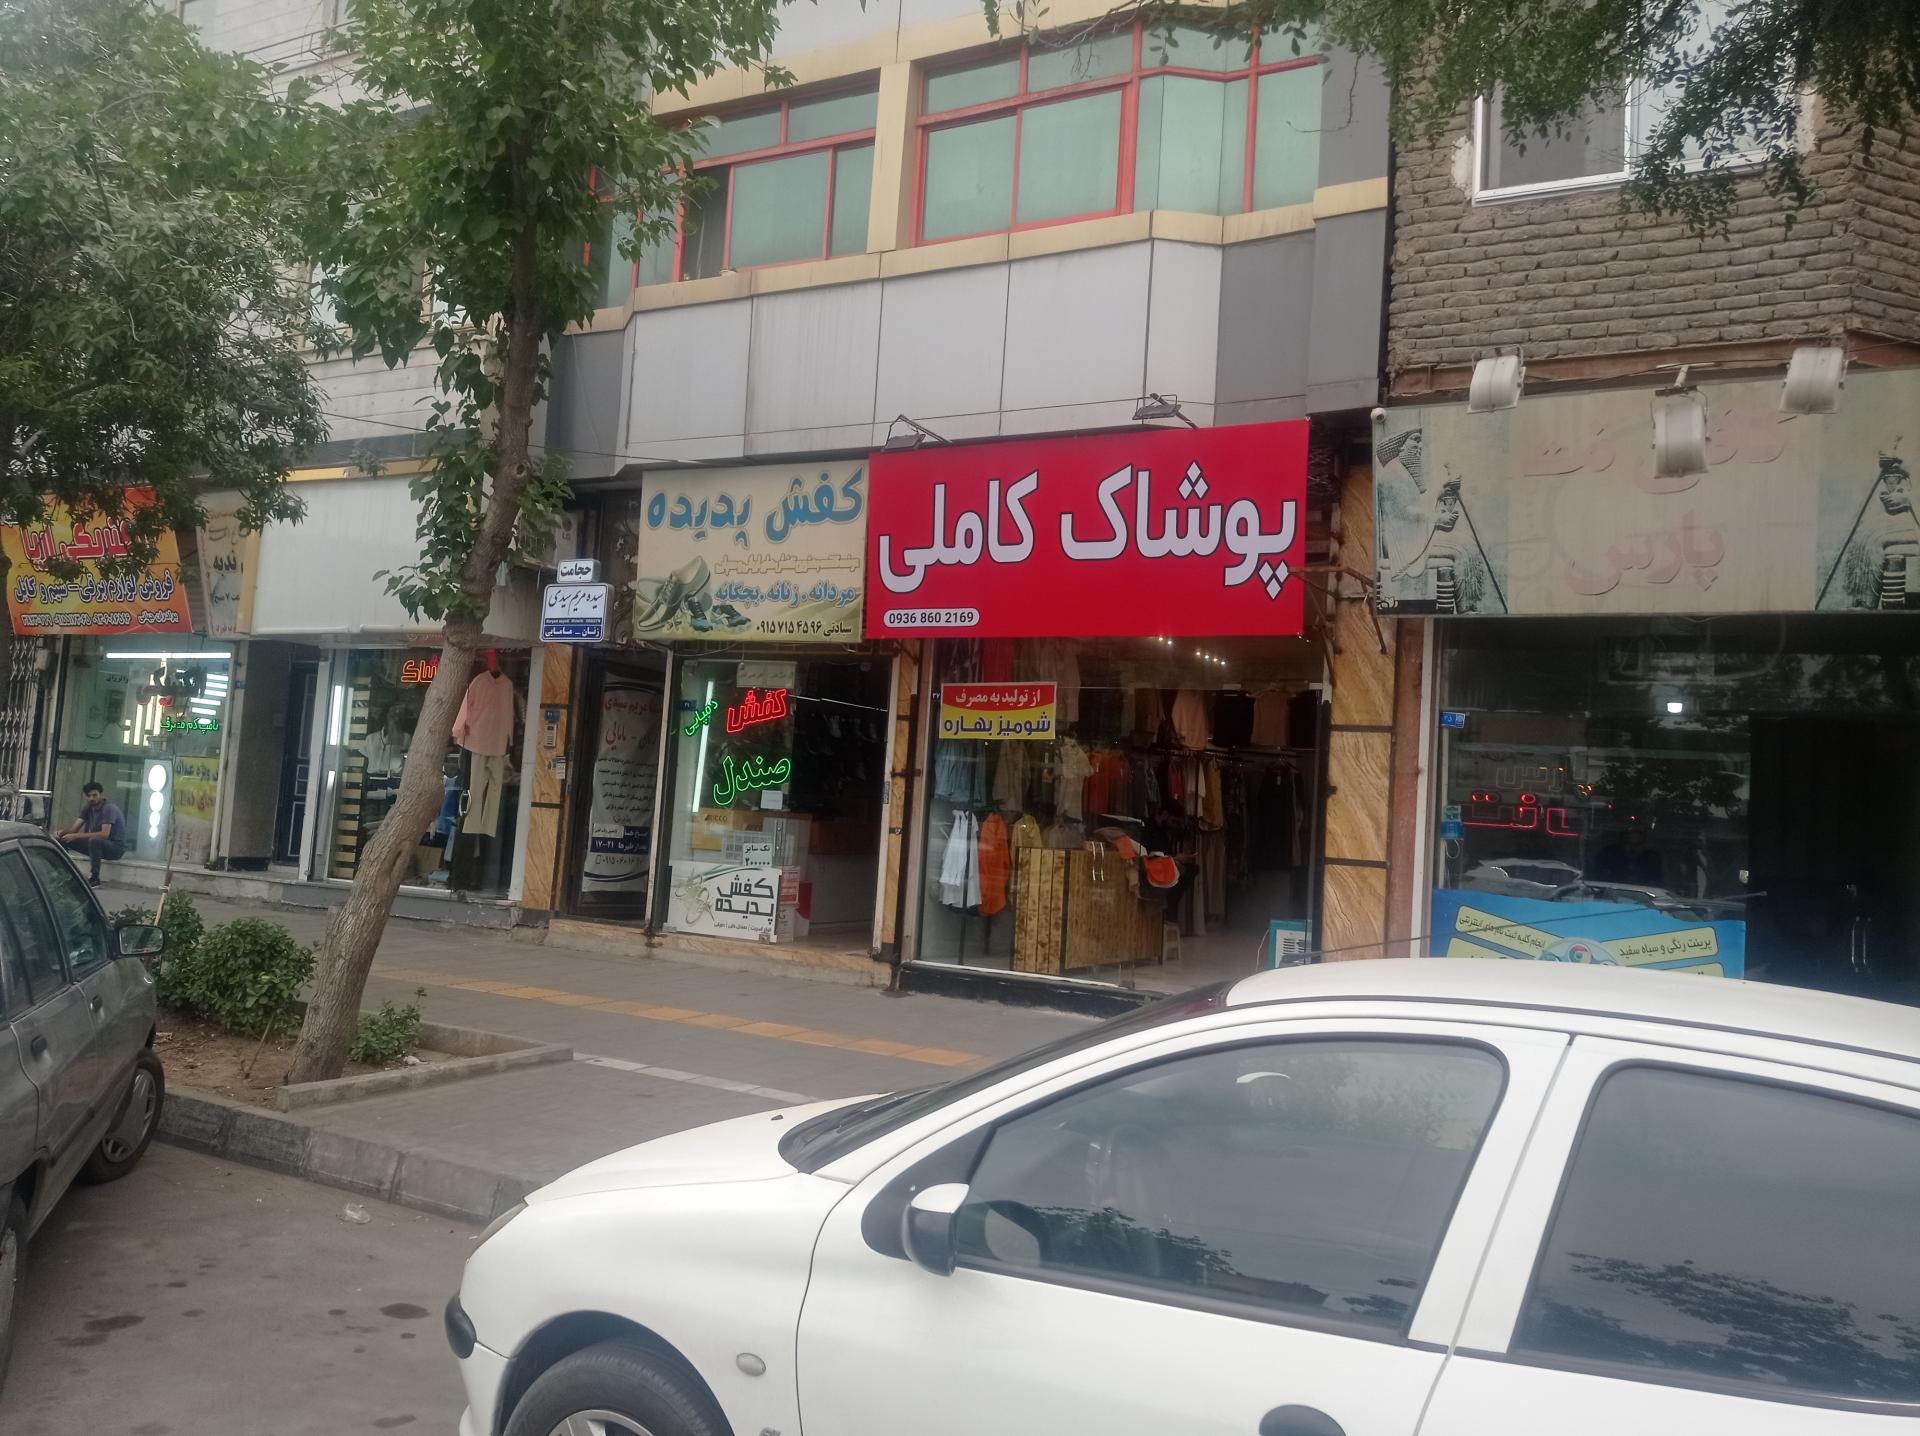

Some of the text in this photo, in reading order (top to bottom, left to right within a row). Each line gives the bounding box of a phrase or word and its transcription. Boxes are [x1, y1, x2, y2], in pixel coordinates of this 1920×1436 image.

[646, 464, 864, 549] کفش پدیده
[879, 460, 1297, 600] پوشاک کاملی
[560, 562, 592, 580] حجامت
[15, 576, 37, 603] کابل
[40, 587, 48, 603] و
[48, 581, 68, 602] سیم
[108, 573, 137, 602] لوازم
[139, 569, 174, 600] فروش
[714, 580, 857, 609] مردانه زنانه بچگانه
[567, 590, 587, 616] مریم
[888, 610, 975, 625] 0936 860 2169
[544, 626, 573, 637] مامایی
[581, 626, 600, 637] زنان
[955, 688, 1041, 707] از تولید به مصرف
[684, 699, 720, 737] دمپایی
[727, 688, 787, 733] کفش
[944, 711, 1051, 736] شومیز بهاره
[713, 755, 792, 806] صندل
[744, 844, 759, 854] سایز
[716, 875, 774, 898] کفش
[714, 897, 775, 925] پدیده
[1619, 937, 1712, 960] پرینت رنگی و سیاه سفید
